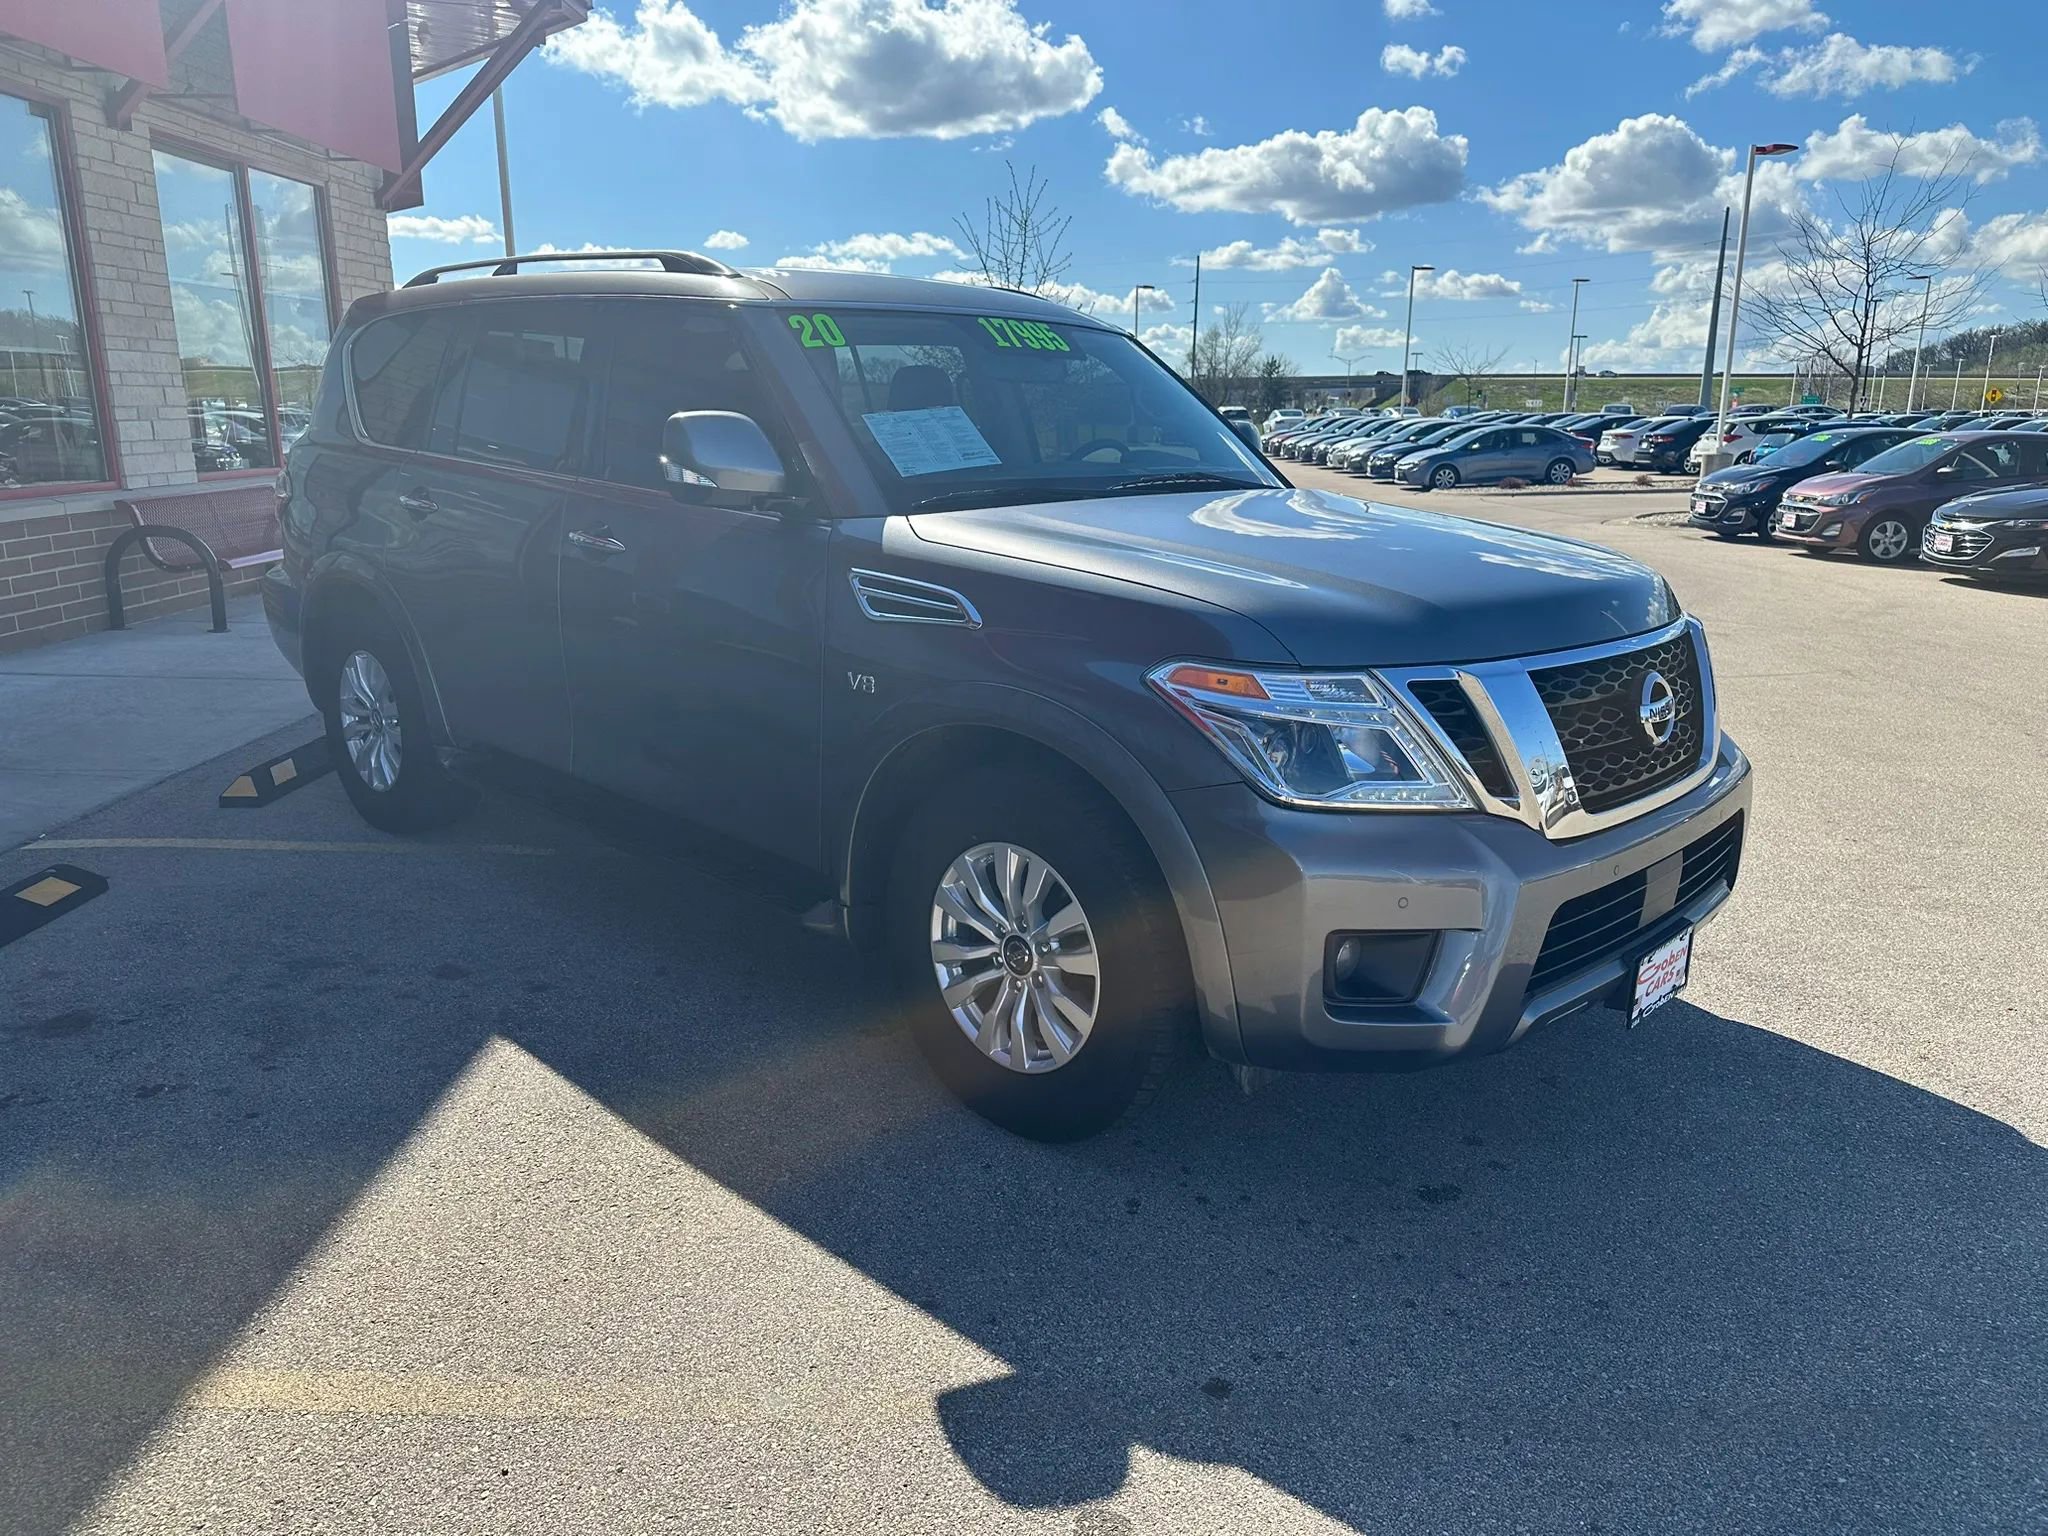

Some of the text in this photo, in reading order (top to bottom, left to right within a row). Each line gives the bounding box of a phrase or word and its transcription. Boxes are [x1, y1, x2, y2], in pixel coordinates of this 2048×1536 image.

[788, 313, 846, 348] 20
[977, 317, 1071, 352] 17995
[847, 671, 875, 694] V8
[1645, 966, 1676, 997] CARS
